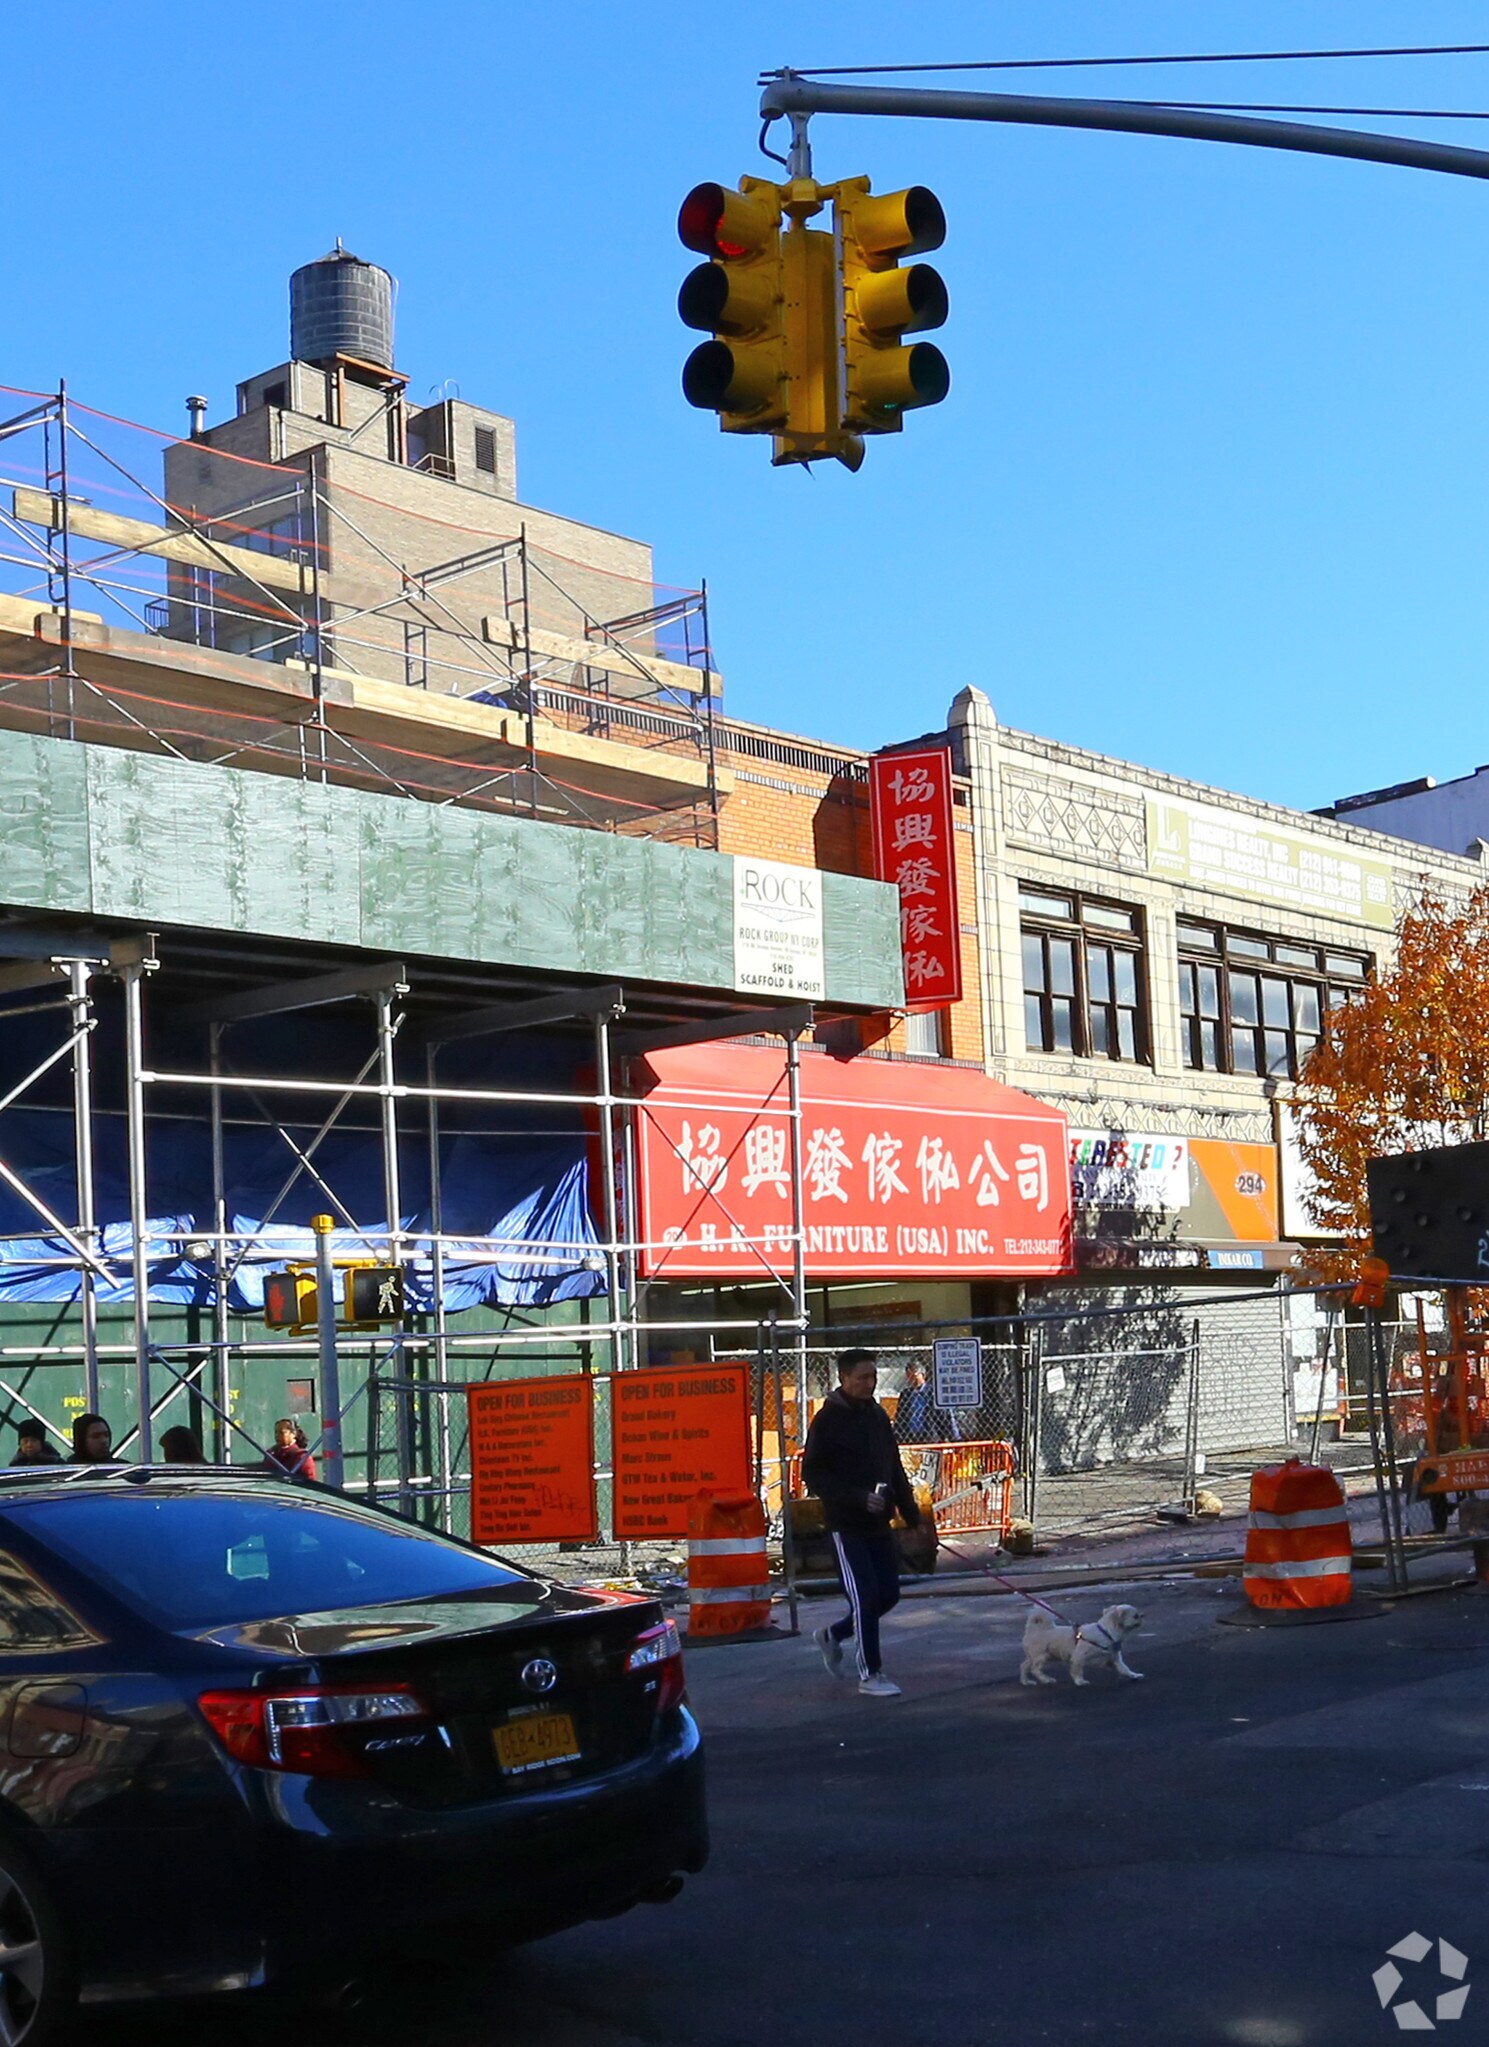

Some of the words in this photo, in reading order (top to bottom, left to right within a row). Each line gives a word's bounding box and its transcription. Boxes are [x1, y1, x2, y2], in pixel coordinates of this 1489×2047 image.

[745, 868, 815, 909] ROCK
[739, 926, 761, 940] ROCK
[764, 929, 789, 944] GROUP
[802, 935, 819, 949] CORP
[772, 961, 794, 975] SHED
[740, 972, 785, 988] SCAFFOLD
[787, 977, 794, 989] &
[797, 979, 821, 993] HOIST
[674, 1119, 1049, 1213] 協興發傢俬公司
[1239, 1174, 1263, 1194] 294
[897, 1225, 948, 1257] (USA)
[956, 1228, 994, 1255] INC.
[942, 1358, 972, 1366] VIOLATORS
[948, 1350, 970, 1358] ILLEGAL
[939, 1366, 949, 1374] MAY
[959, 1365, 975, 1373] FINED
[621, 1384, 650, 1401] OPEN
[652, 1381, 675, 1399] FOR
[677, 1376, 737, 1397] BUSINESS
[477, 1395, 502, 1411] OPEN
[506, 1393, 525, 1409] FOR
[528, 1388, 581, 1407] BUSINESS
[647, 1514, 669, 1526] Bank
